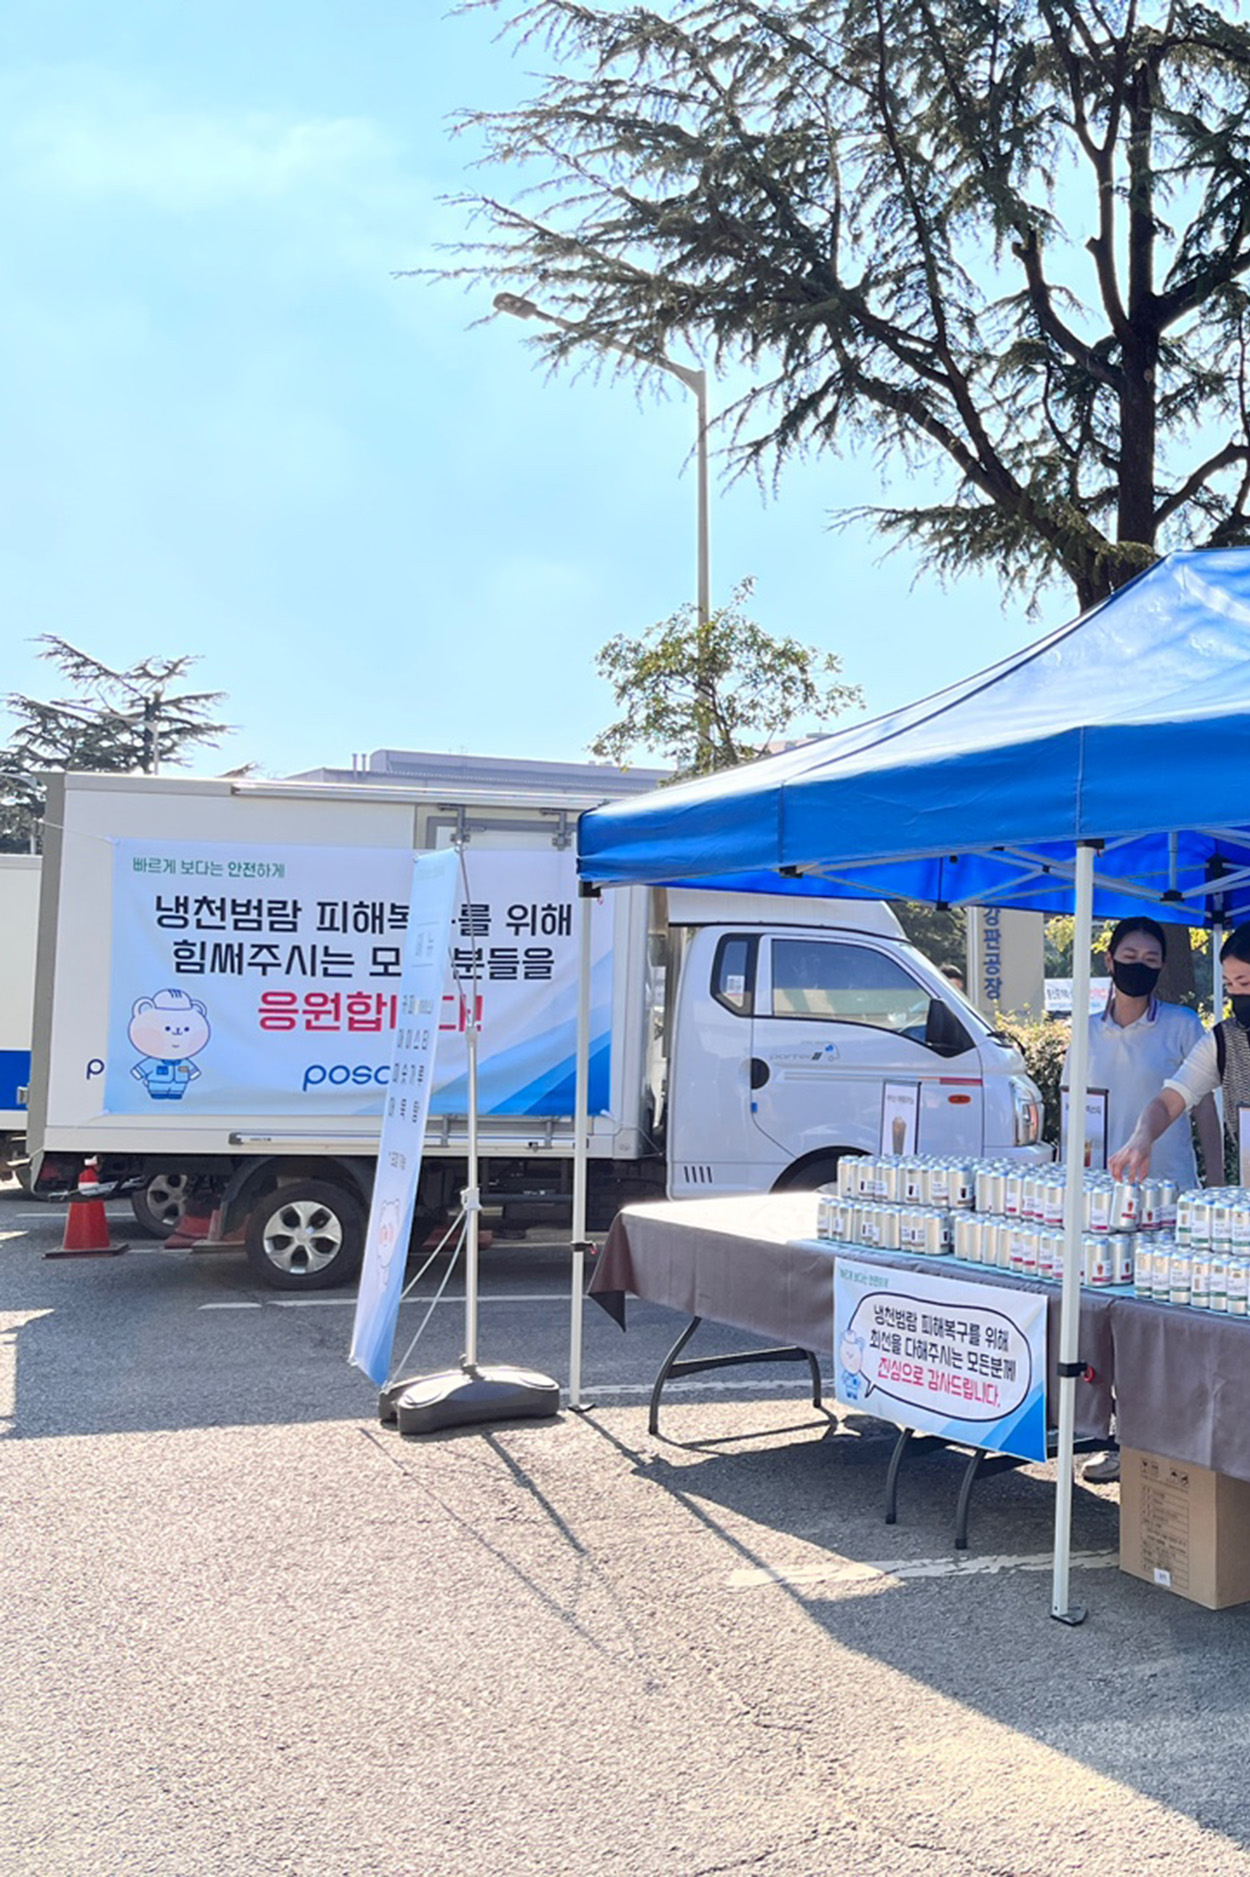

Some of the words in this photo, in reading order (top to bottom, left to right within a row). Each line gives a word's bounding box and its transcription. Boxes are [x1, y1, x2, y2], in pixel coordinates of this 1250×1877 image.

[133, 857, 176, 874] 빠르게
[181, 860, 224, 877] 보다는
[228, 861, 286, 878] 안전하게
[155, 895, 302, 933] 냉천범람
[316, 900, 491, 938] 피해복를
[506, 903, 573, 937] 위해
[173, 939, 355, 978] 힘써주시는
[451, 947, 555, 980] 분들을
[258, 991, 483, 1032] 응원합다!
[303, 1064, 390, 1092] posc
[873, 1304, 918, 1334] 냉천범람
[921, 1313, 981, 1347] 피해복구를
[985, 1326, 1010, 1353] 위해
[869, 1328, 902, 1356] 최선을
[905, 1336, 964, 1371] 다해주시는
[966, 1350, 1017, 1382] 모든분께
[878, 1356, 925, 1387] 진심으로
[927, 1368, 1001, 1408] 감사드립니다.
